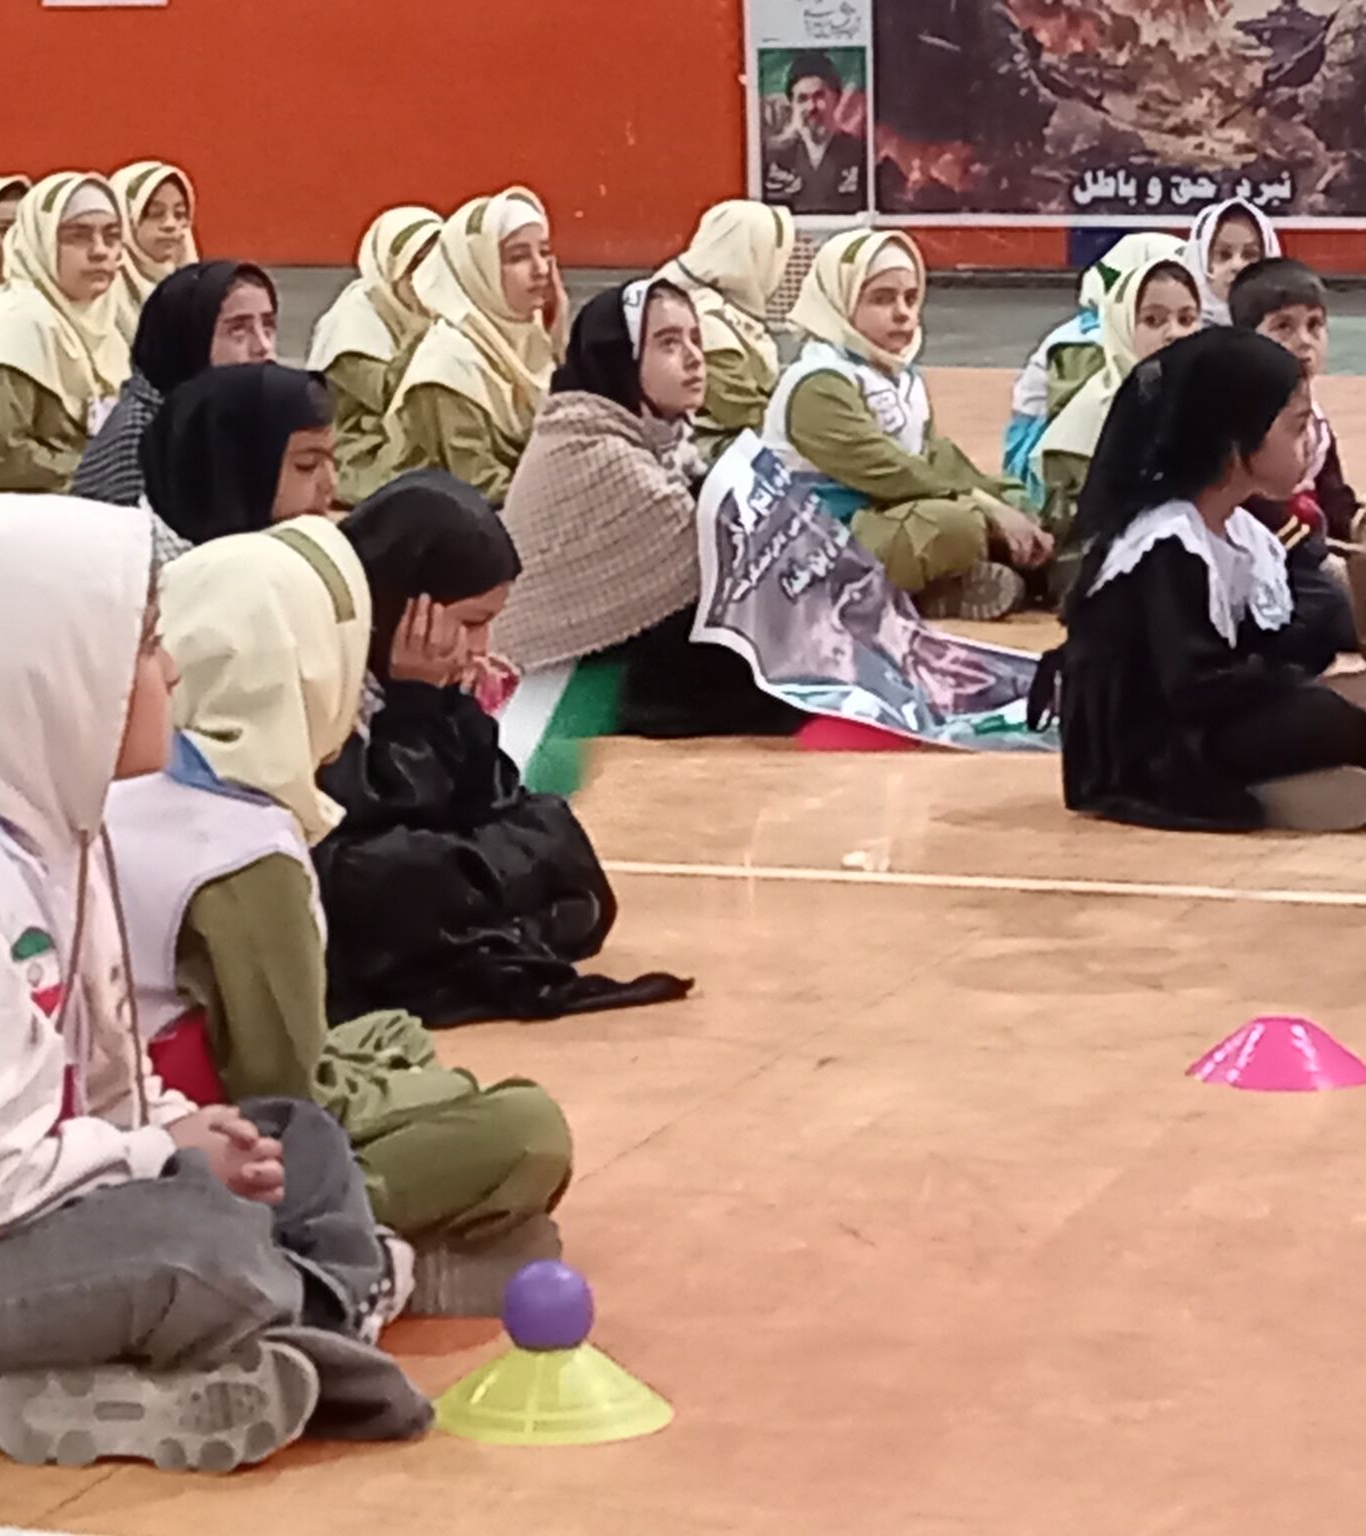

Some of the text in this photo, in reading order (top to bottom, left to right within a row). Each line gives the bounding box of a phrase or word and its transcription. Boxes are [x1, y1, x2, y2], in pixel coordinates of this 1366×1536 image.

[1073, 170, 1292, 207] نبرد حق و باطل
